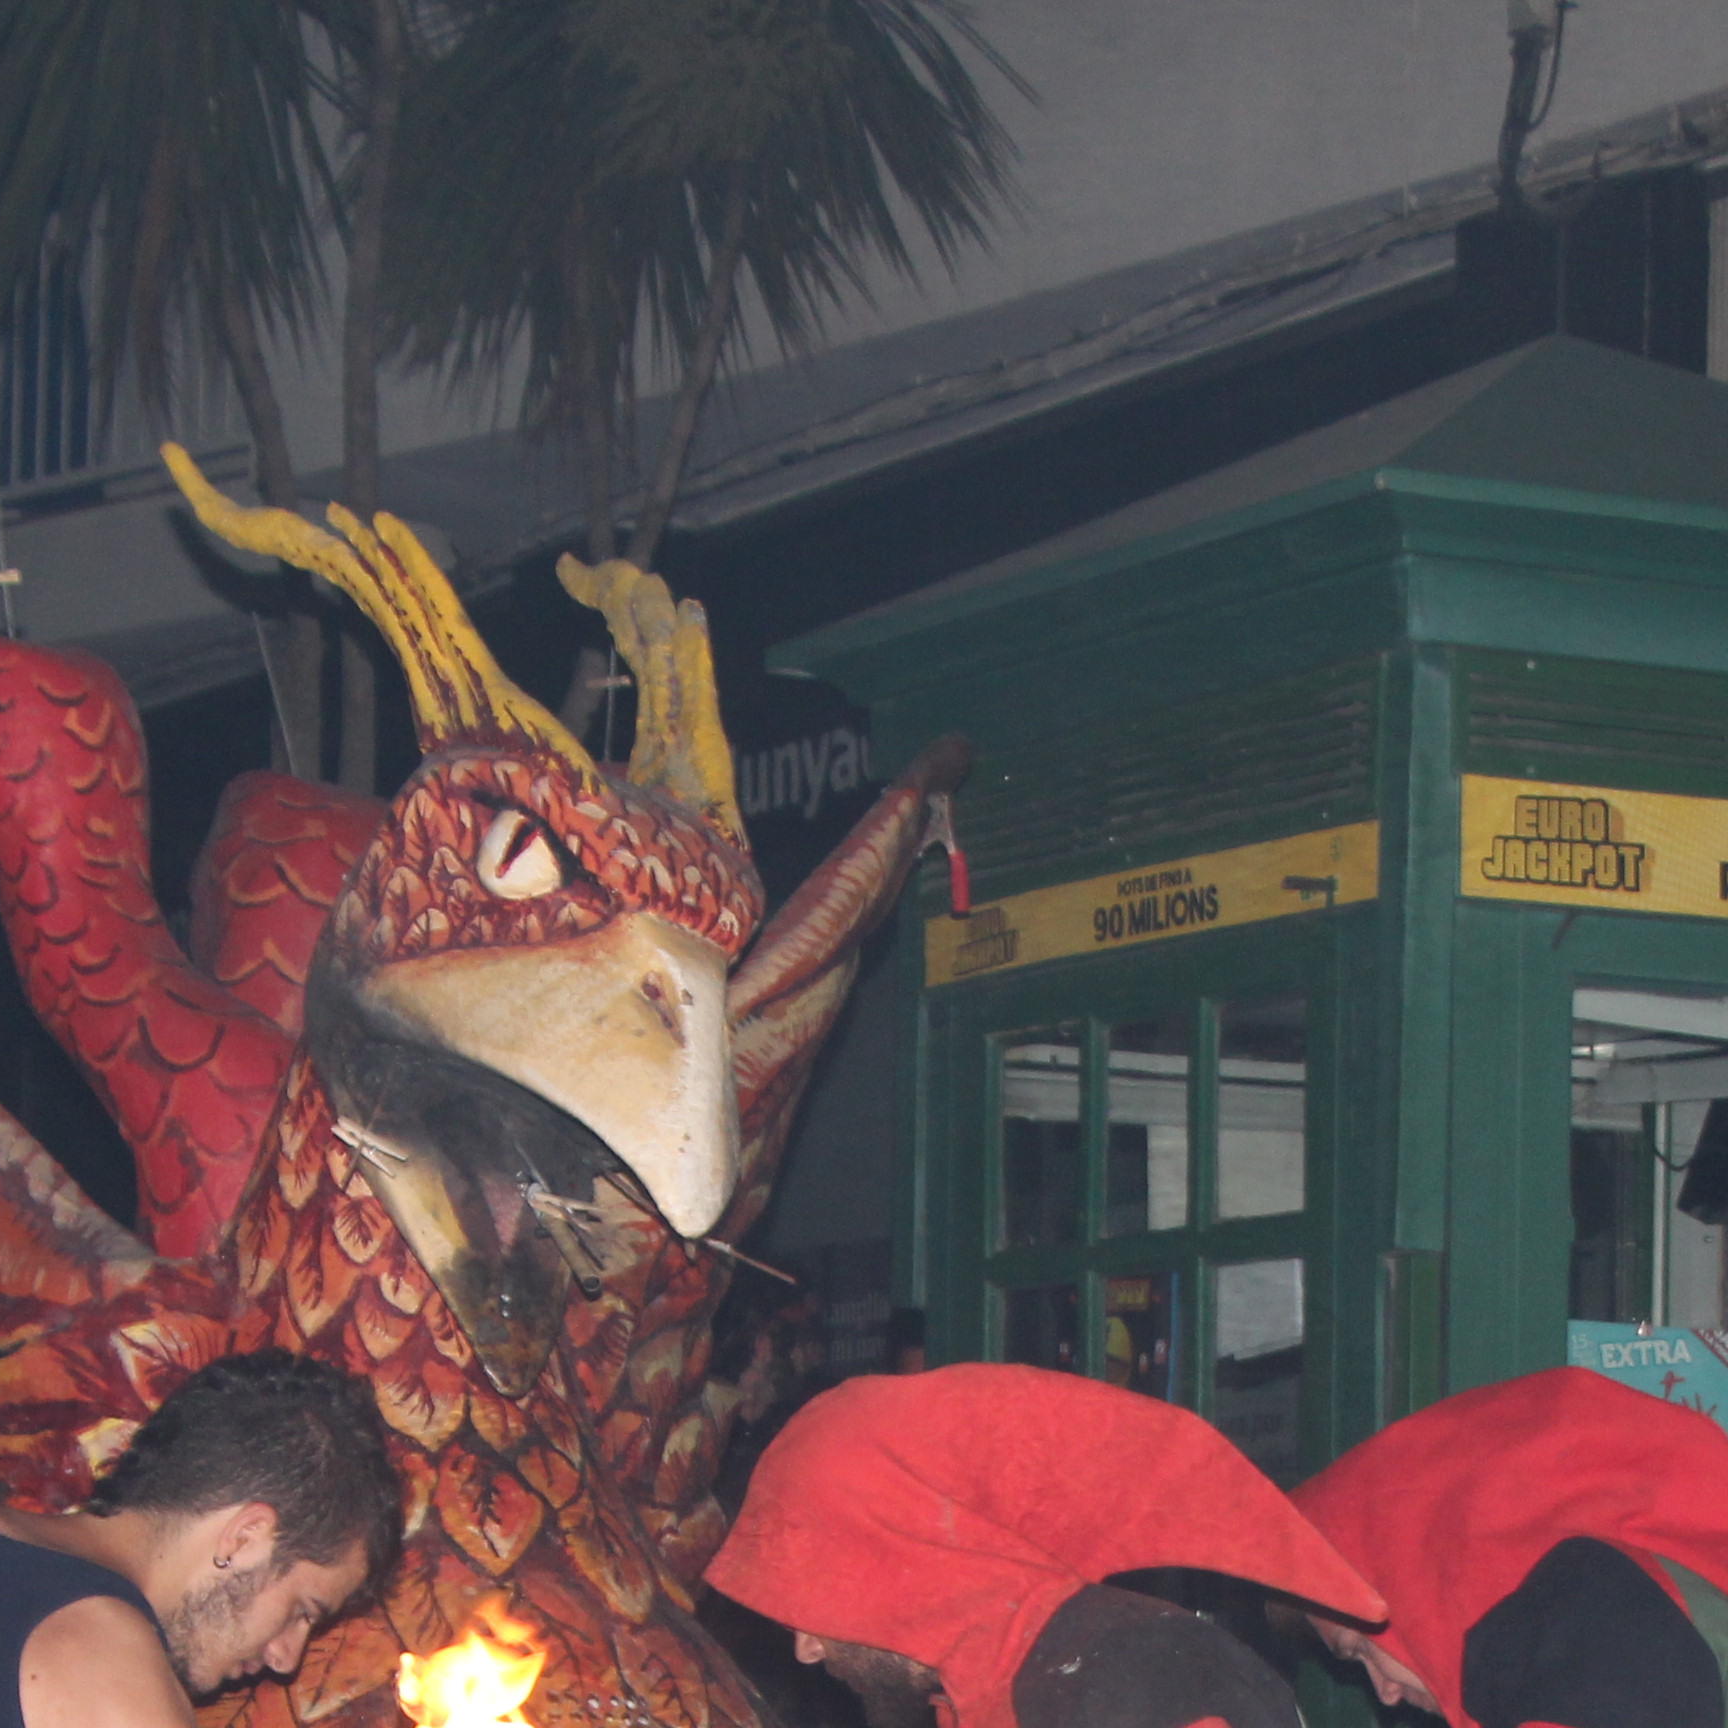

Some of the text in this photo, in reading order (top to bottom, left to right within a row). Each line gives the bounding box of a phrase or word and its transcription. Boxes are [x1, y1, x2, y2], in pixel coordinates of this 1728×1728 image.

[1514, 795, 1609, 841] EURO
[1481, 836, 1645, 892] JACKPOT
[1093, 883, 1219, 941] 90 MILIONS
[1600, 1338, 1693, 1369] EXTRA
